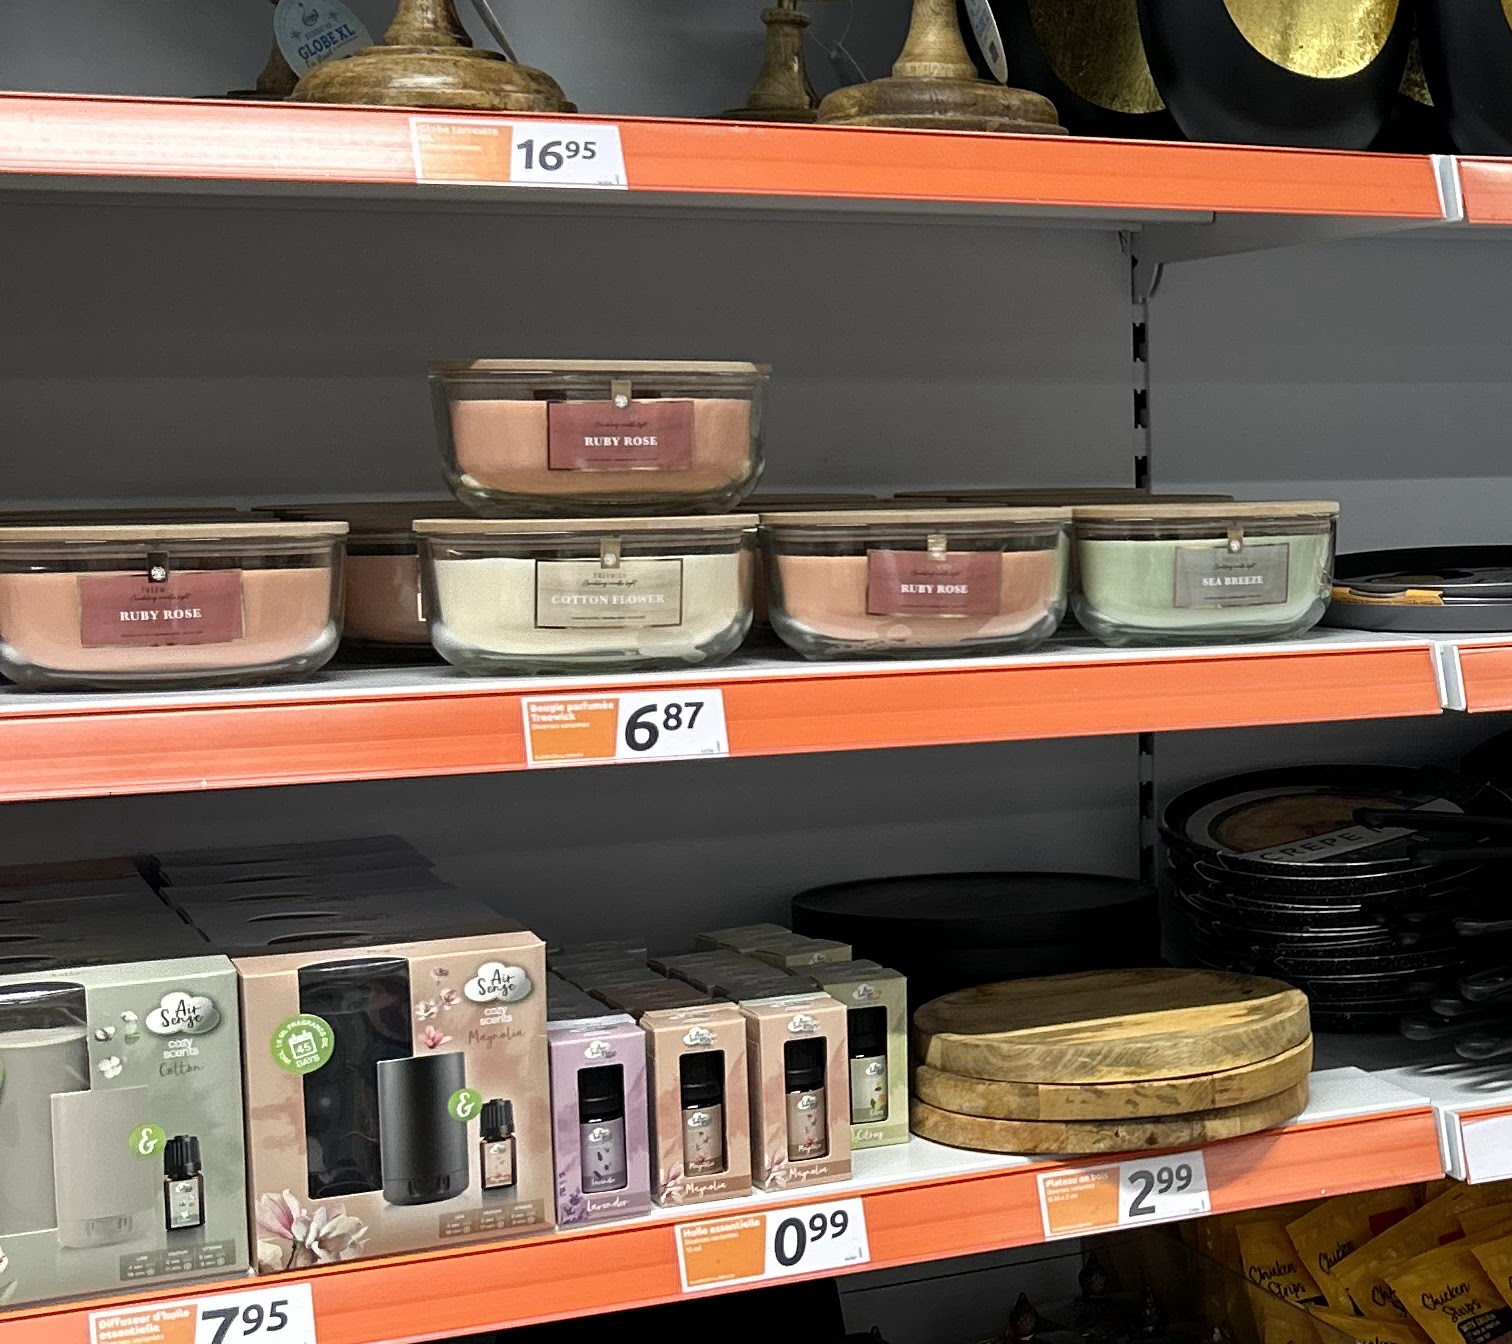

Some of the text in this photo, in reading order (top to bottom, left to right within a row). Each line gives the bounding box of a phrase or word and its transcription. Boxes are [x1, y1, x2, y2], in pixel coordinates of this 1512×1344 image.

[297, 32, 339, 60] GLOBE
[339, 24, 356, 41] XL
[584, 436, 658, 446] RUBY ROSE
[1202, 575, 1264, 586] SEA BREEZE
[901, 584, 968, 594] RUBY ROSE
[551, 594, 665, 605] COTTON FLOWER
[120, 608, 202, 621] RUBY ROSE
[491, 969, 516, 986] Air
[175, 999, 202, 1017] Air
[468, 1026, 526, 1049] Magnolia
[297, 1042, 312, 1054] 45
[159, 1061, 205, 1077] Cotton
[1420, 1281, 1471, 1310] Chicken
[98, 1313, 151, 1330] Diffuseur
